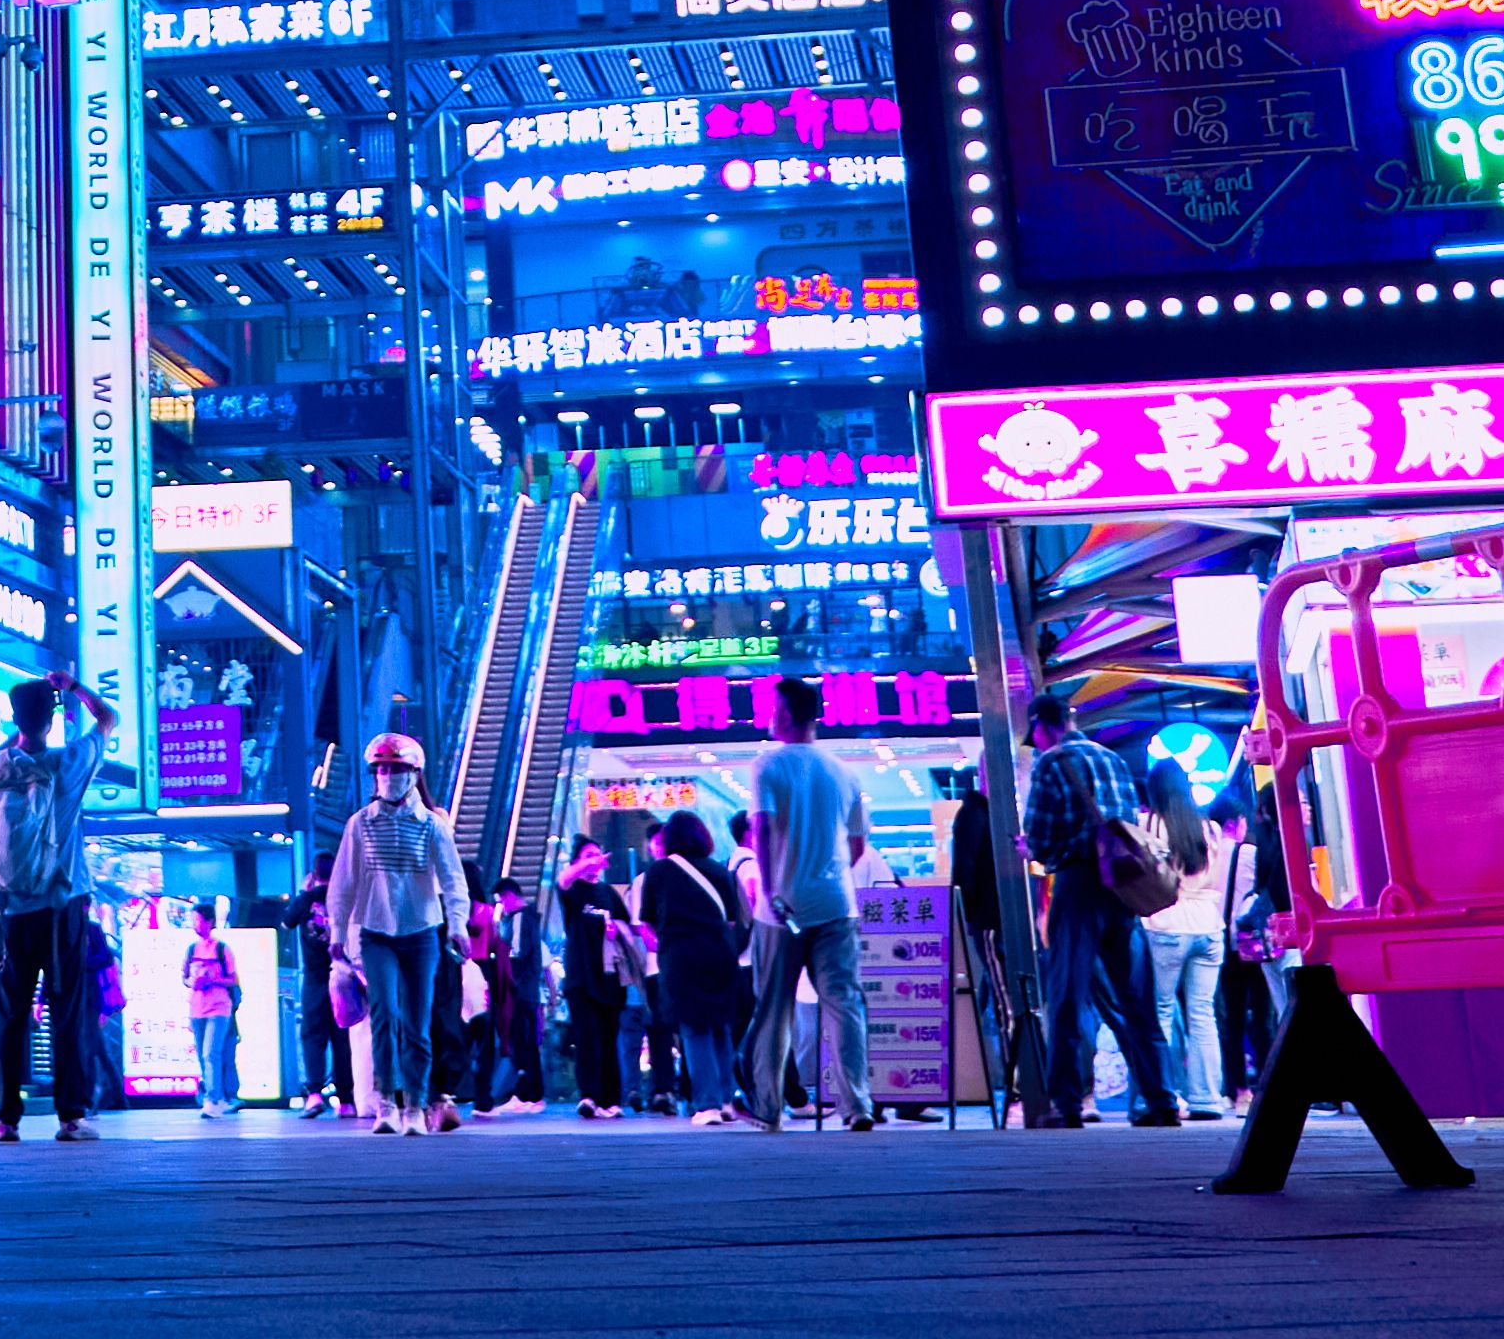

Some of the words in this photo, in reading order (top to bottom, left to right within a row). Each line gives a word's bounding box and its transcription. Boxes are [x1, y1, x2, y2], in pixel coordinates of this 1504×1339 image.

[1147, 3, 1283, 41] Eighteen
[86, 30, 106, 63] YI
[1150, 43, 1244, 76] kinds
[86, 90, 110, 211] WORLD
[1211, 168, 1253, 195] and
[89, 236, 111, 278] DE
[91, 308, 111, 342] YI
[321, 381, 386, 398] MASK
[91, 373, 115, 501] WORLD
[95, 527, 118, 570] DE
[96, 603, 119, 637] YI
